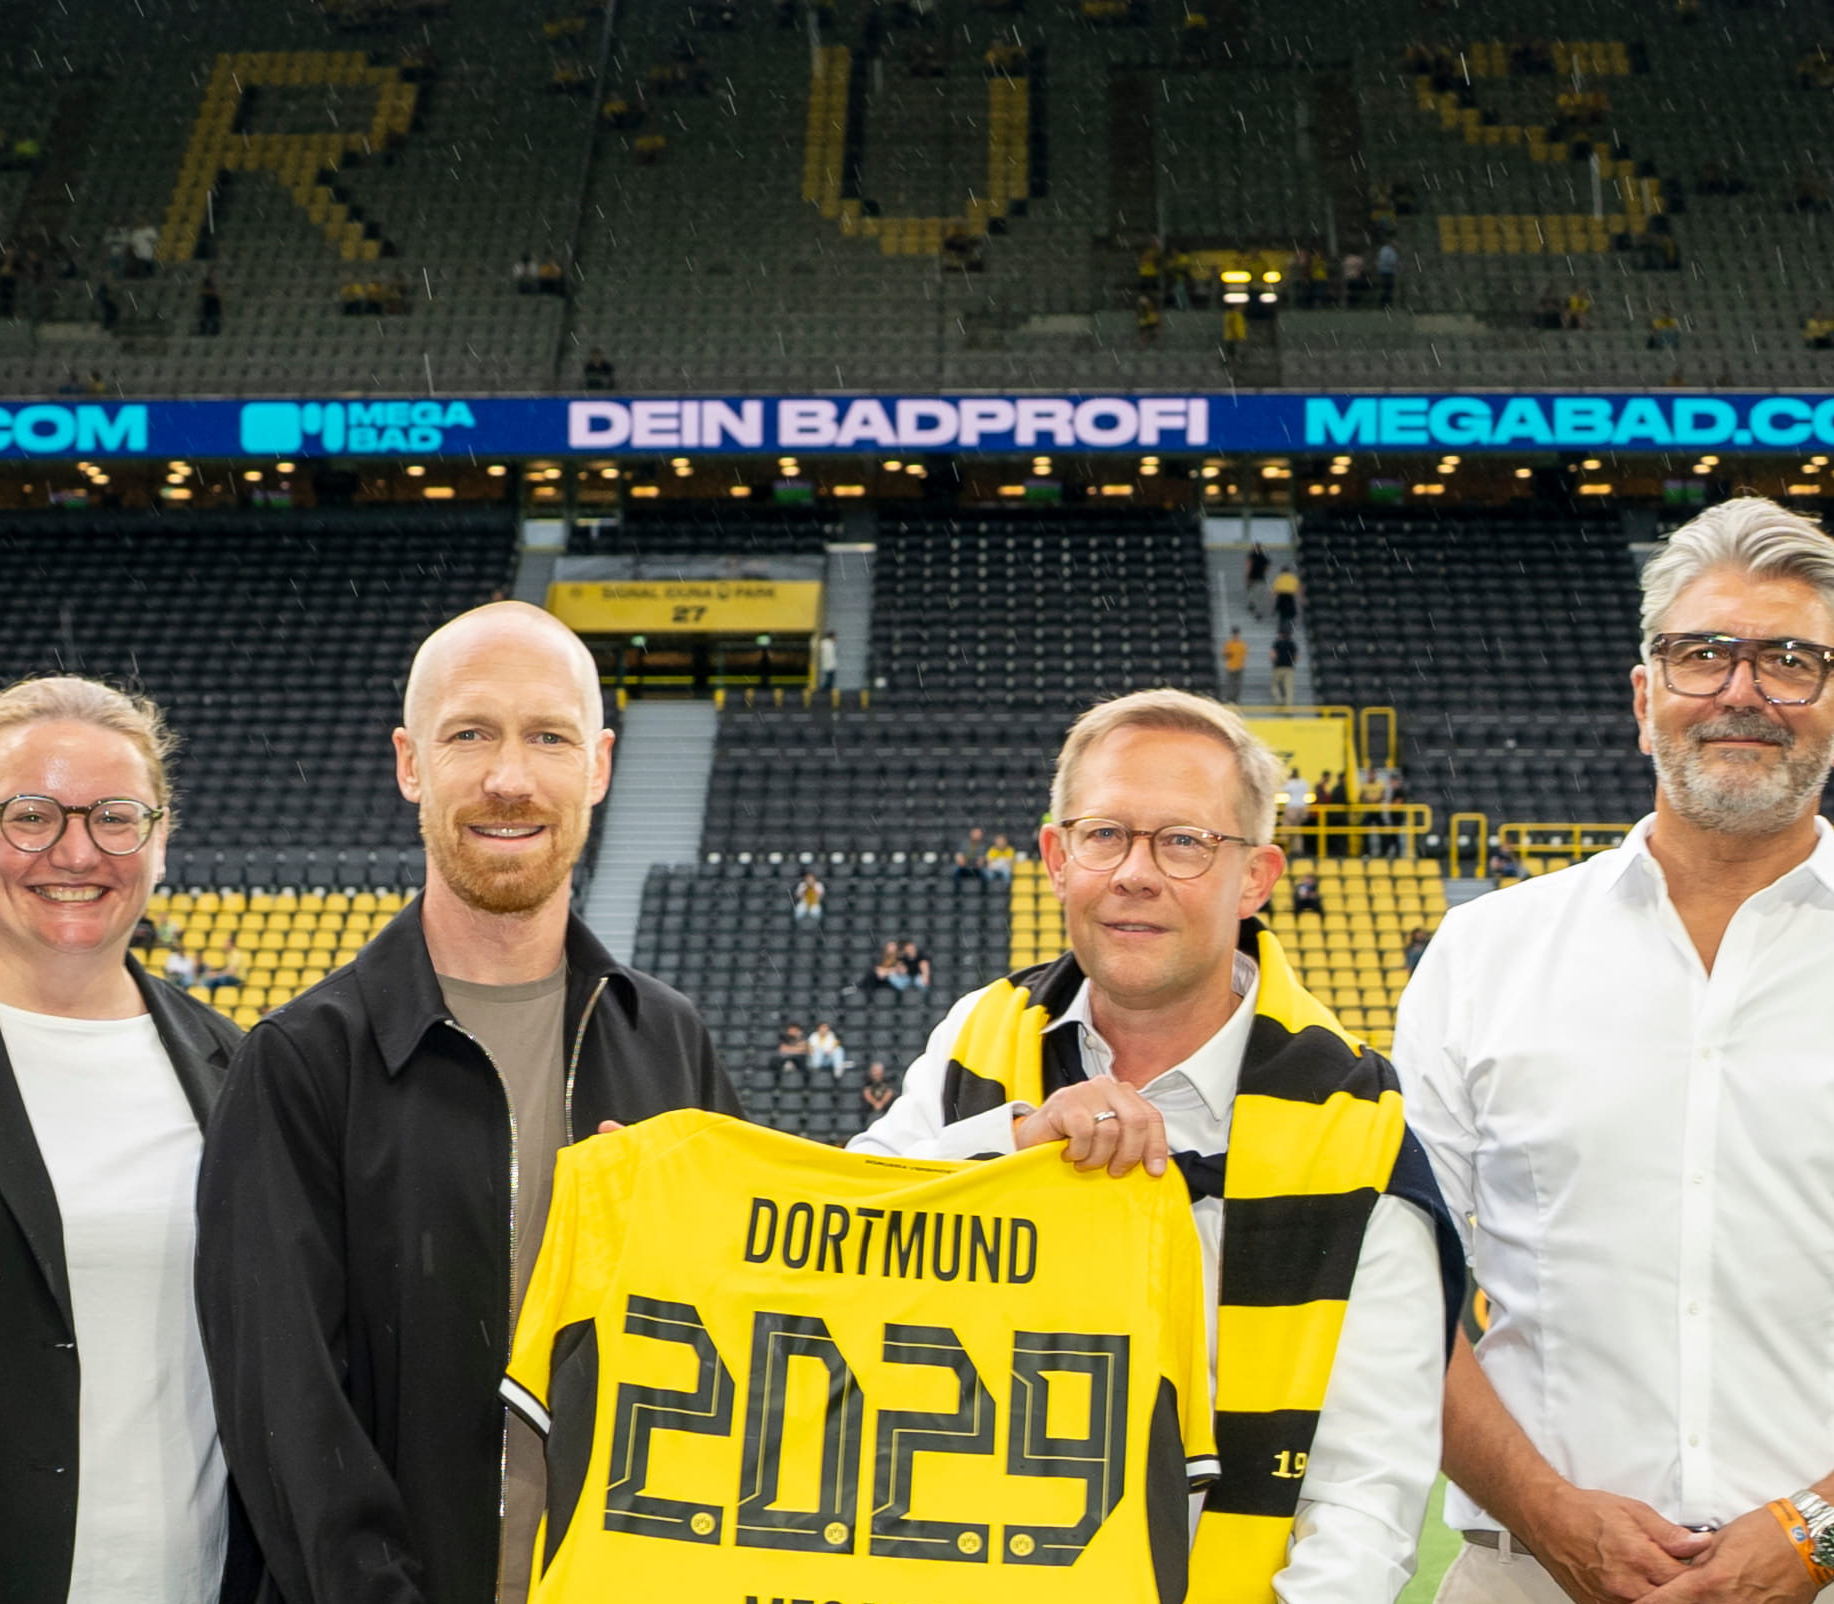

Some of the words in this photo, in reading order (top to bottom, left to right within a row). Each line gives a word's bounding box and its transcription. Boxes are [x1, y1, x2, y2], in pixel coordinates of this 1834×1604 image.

[348, 401, 476, 428] MEGA
[568, 399, 764, 450] DEIN
[777, 397, 1208, 447] BADPROFI
[348, 427, 442, 453] BAD
[672, 606, 706, 622] 27
[744, 1197, 1039, 1284] DORTMUND
[603, 1294, 1131, 1567] 2029
[1271, 1450, 1308, 1478] 19
